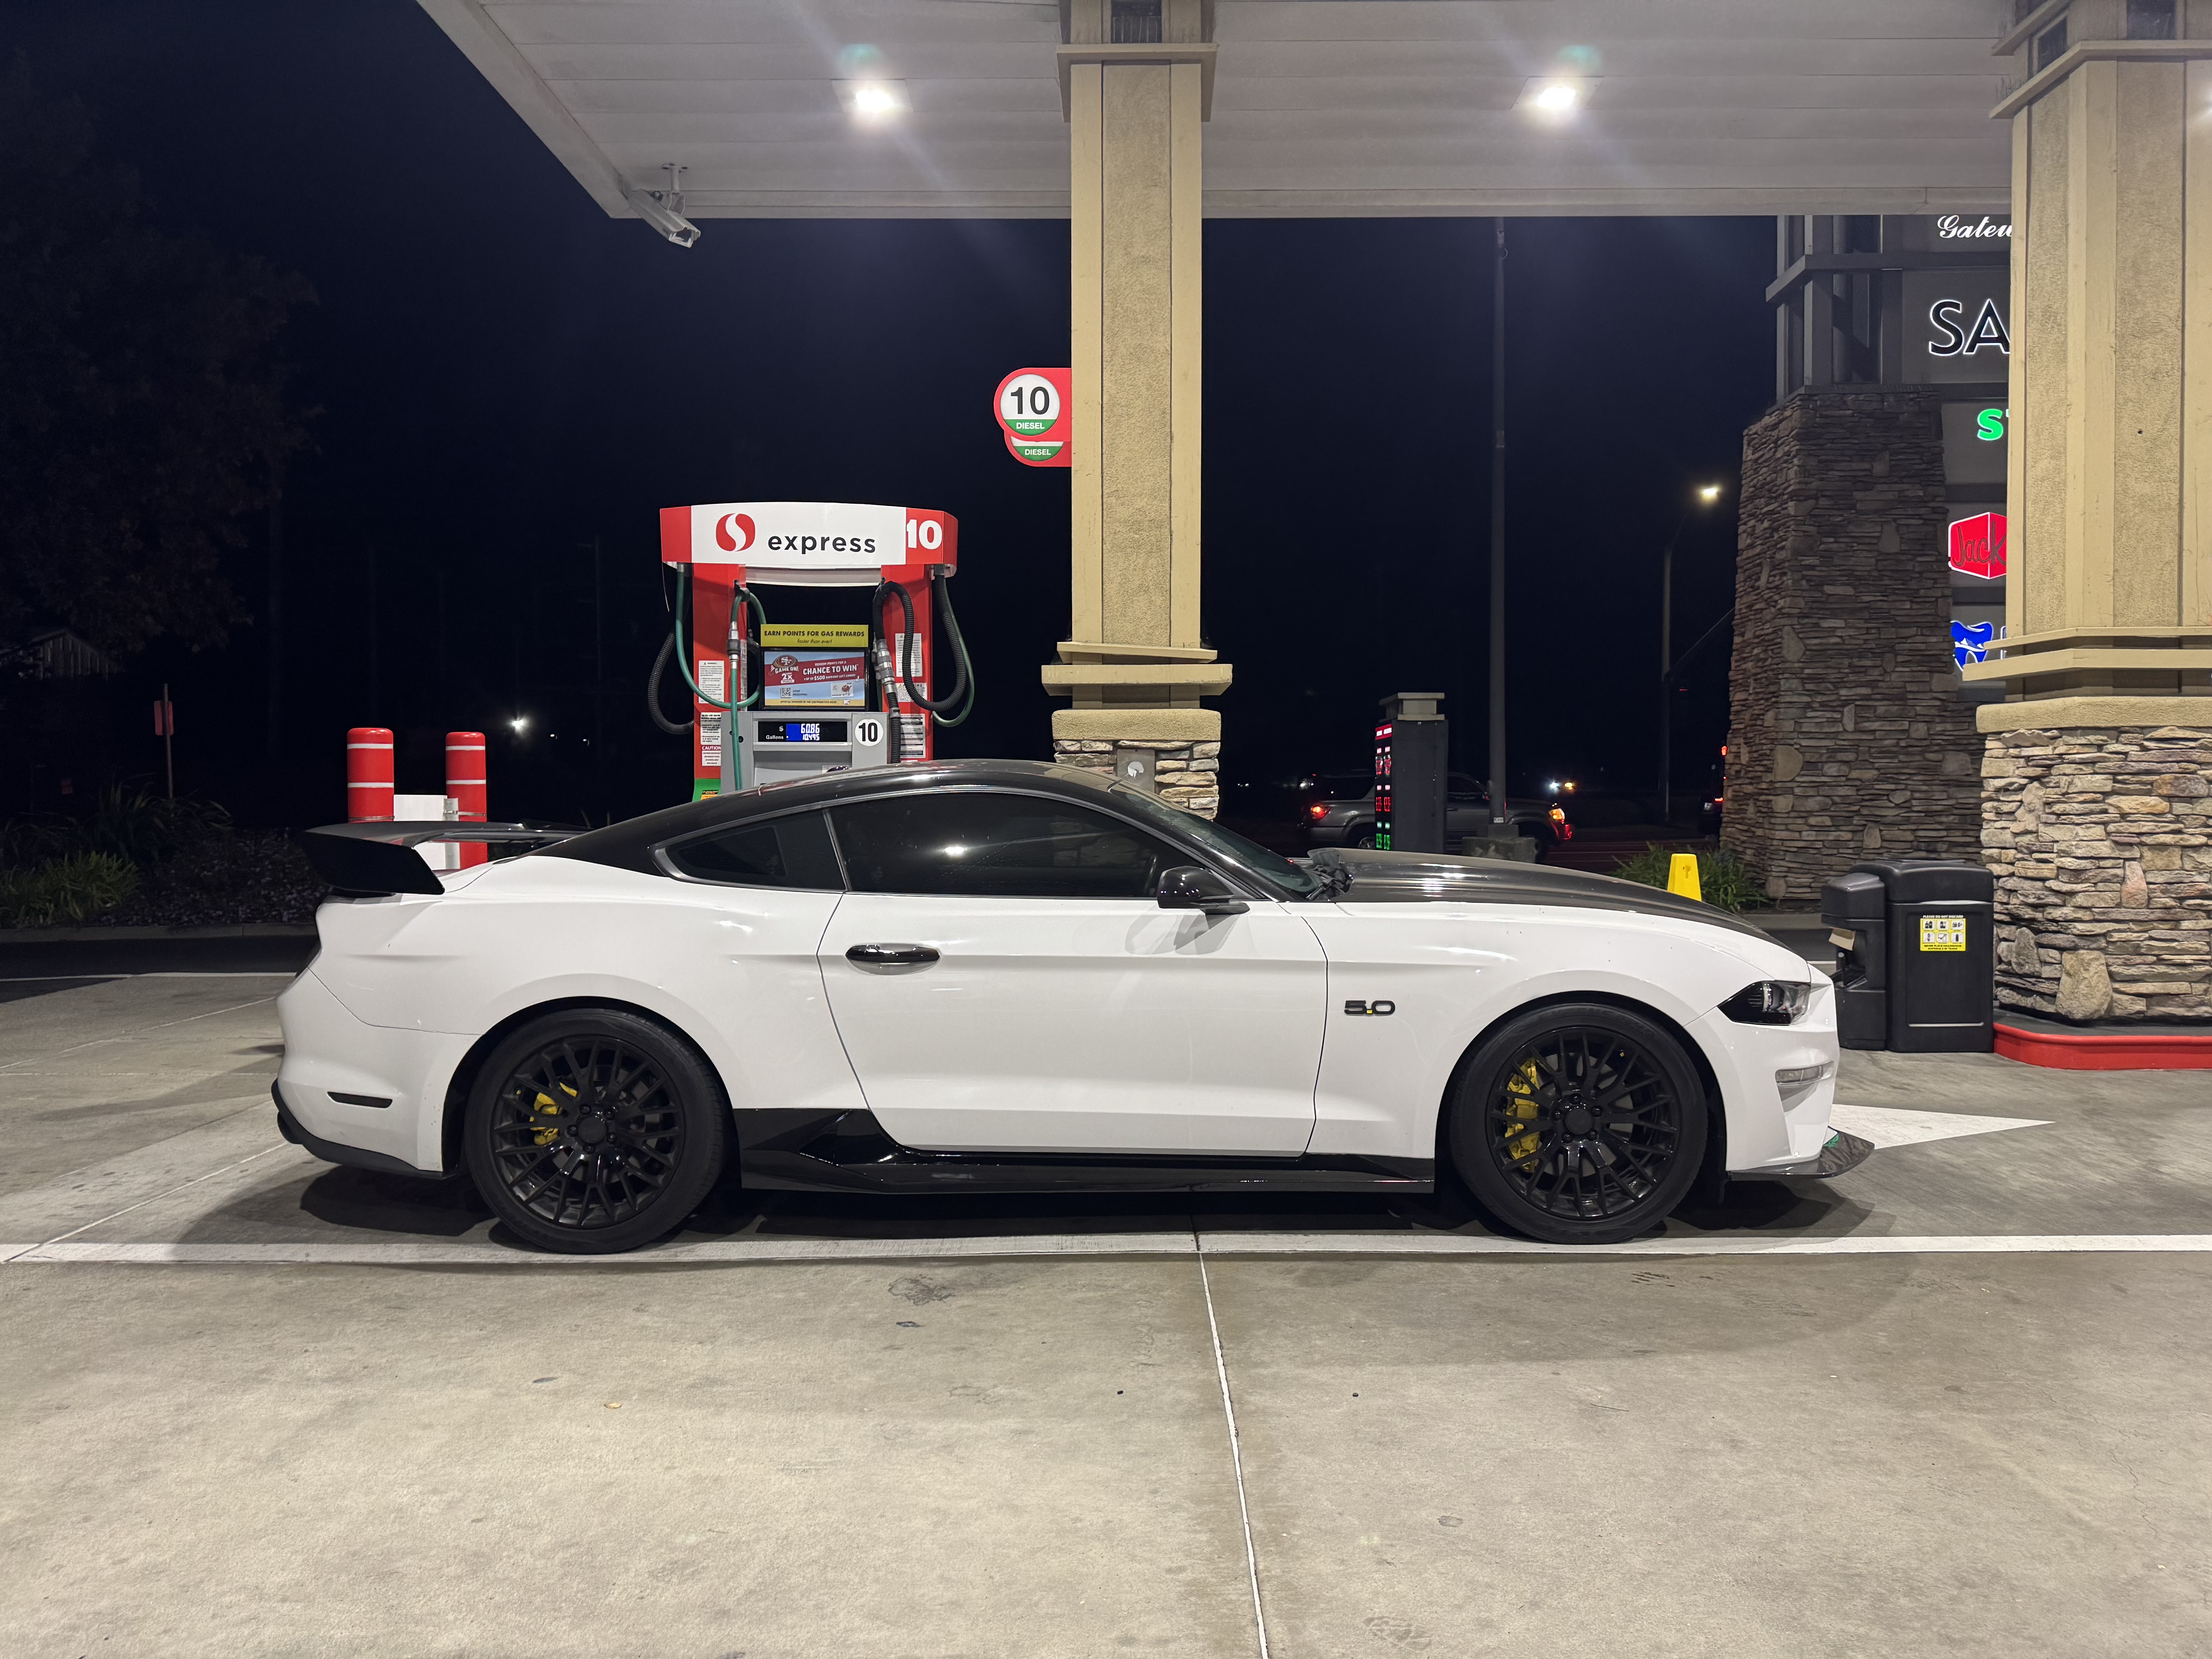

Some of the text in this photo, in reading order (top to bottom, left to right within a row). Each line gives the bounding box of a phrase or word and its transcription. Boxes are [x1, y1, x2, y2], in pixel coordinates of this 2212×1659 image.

[1010, 386, 1049, 415] 10
[1977, 409, 2009, 441] S
[906, 519, 942, 550] 10
[1952, 520, 2007, 567] Jack
[768, 536, 876, 555] express
[781, 657, 792, 665] SF
[803, 667, 830, 675] CHANCE
[858, 723, 878, 742] 10
[1344, 1000, 1396, 1015] 5.0
